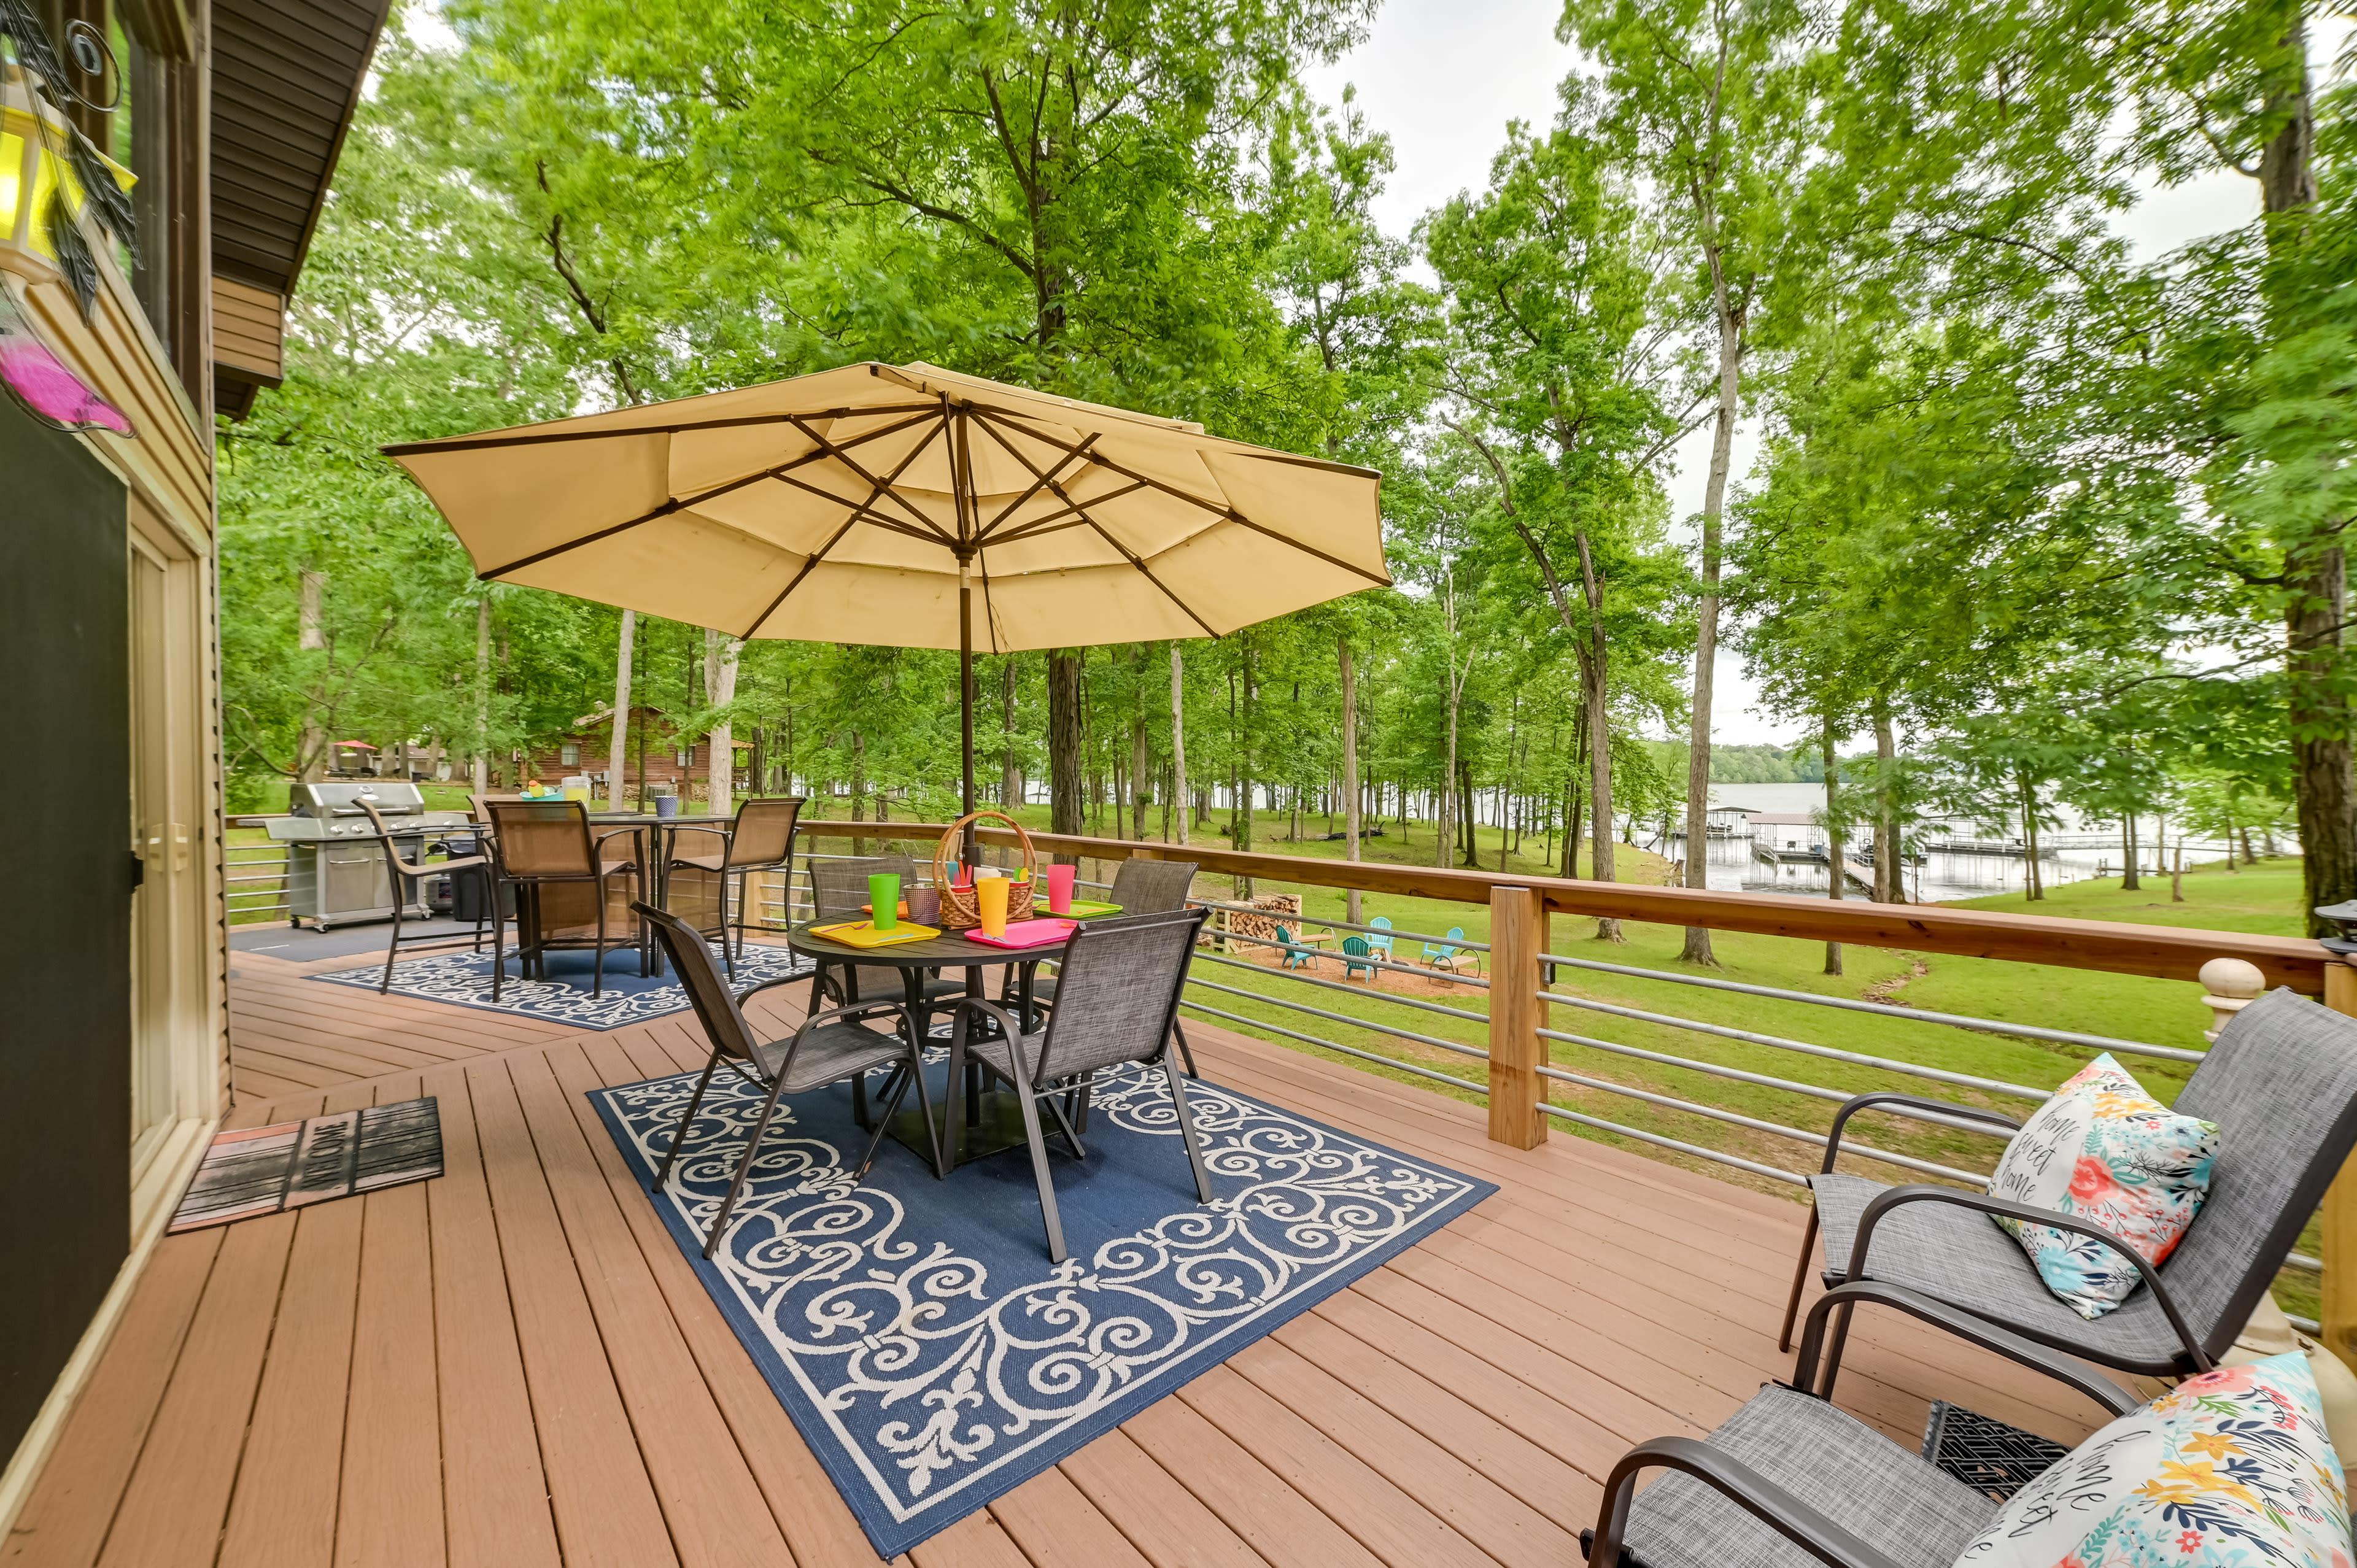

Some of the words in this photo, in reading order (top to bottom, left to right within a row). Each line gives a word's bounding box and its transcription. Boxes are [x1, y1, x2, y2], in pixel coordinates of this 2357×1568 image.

[2037, 1100, 2080, 1145] home
[300, 1121, 348, 1190] WELCOME
[2002, 1151, 2035, 1202] home
[2009, 1133, 2056, 1175] sweet
[2056, 1431, 2151, 1511] home
